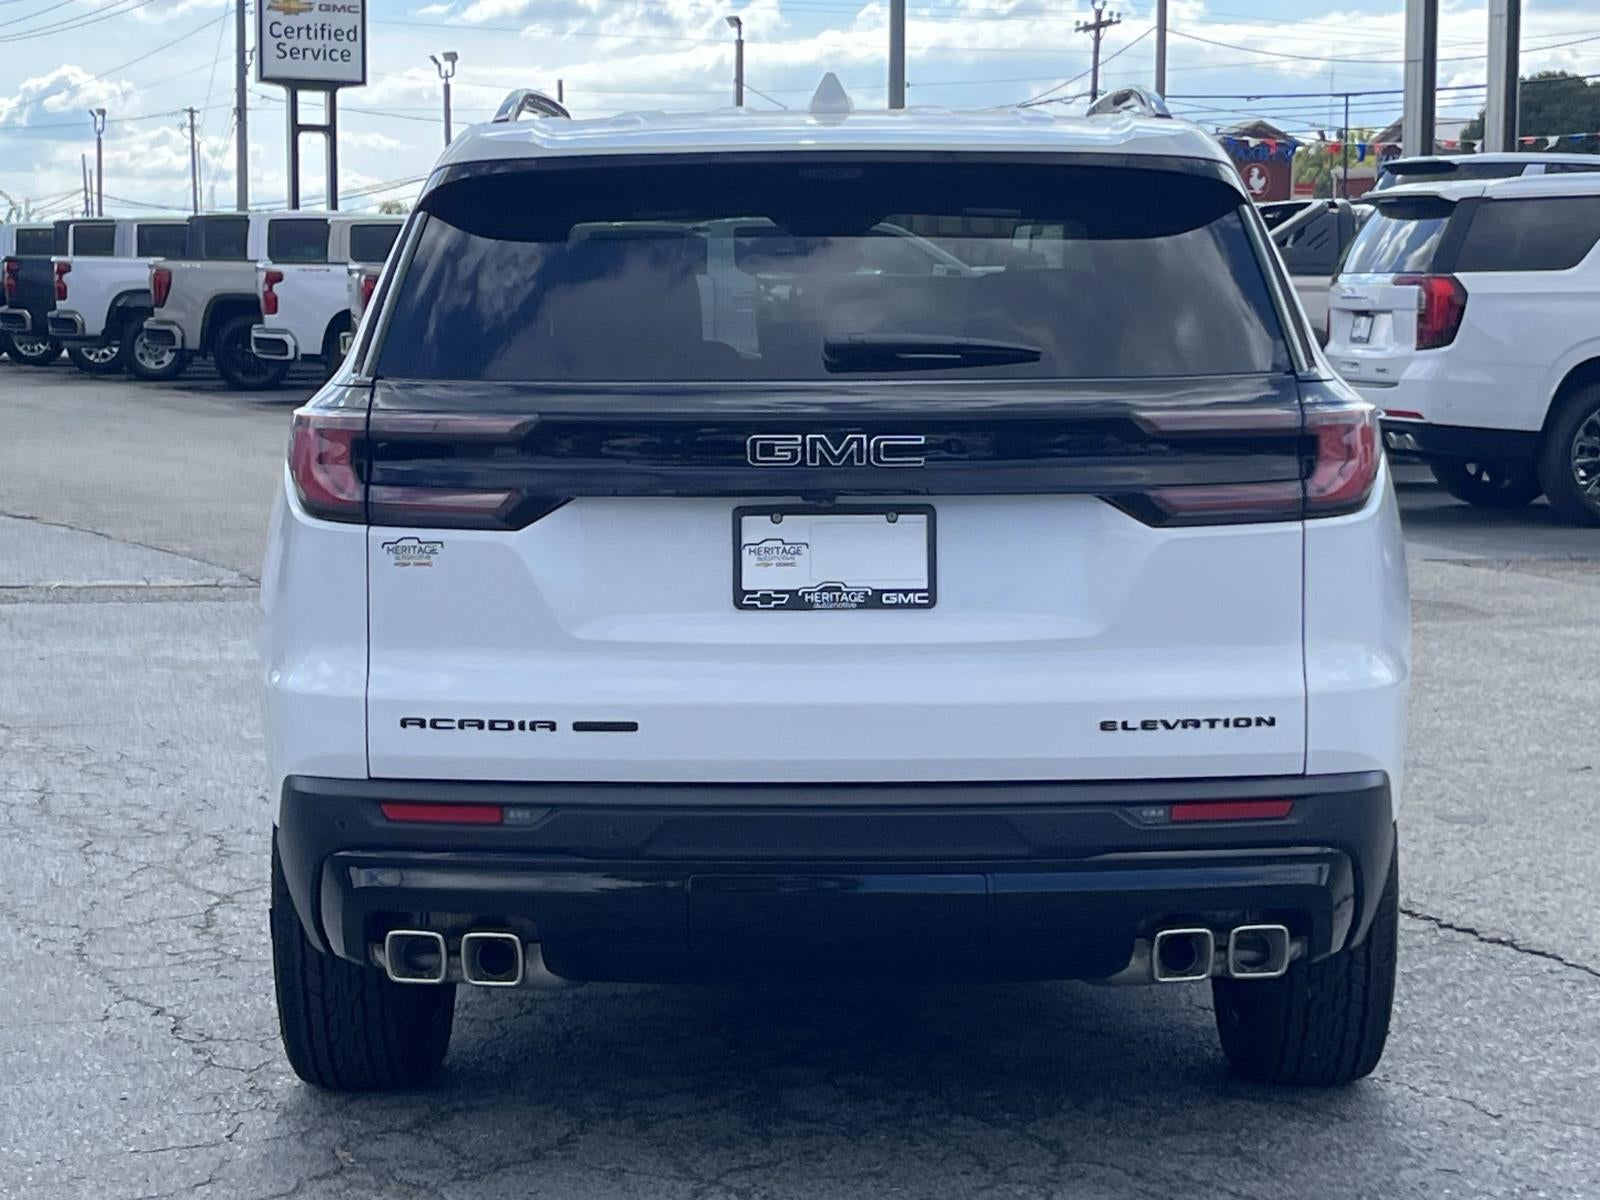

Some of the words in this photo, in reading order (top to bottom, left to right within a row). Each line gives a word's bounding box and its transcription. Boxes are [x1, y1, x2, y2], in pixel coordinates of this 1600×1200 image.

[318, 3, 360, 14] GMC
[269, 21, 358, 42] Certified
[276, 42, 352, 62] Service
[746, 434, 926, 468] GMC
[386, 544, 439, 555] HERITAGE
[748, 546, 803, 556] HERITAGE
[804, 591, 866, 603] HERITAGE
[881, 592, 930, 604] GMC
[400, 717, 557, 732] ACADIA
[1099, 716, 1277, 732] ELEVATION
